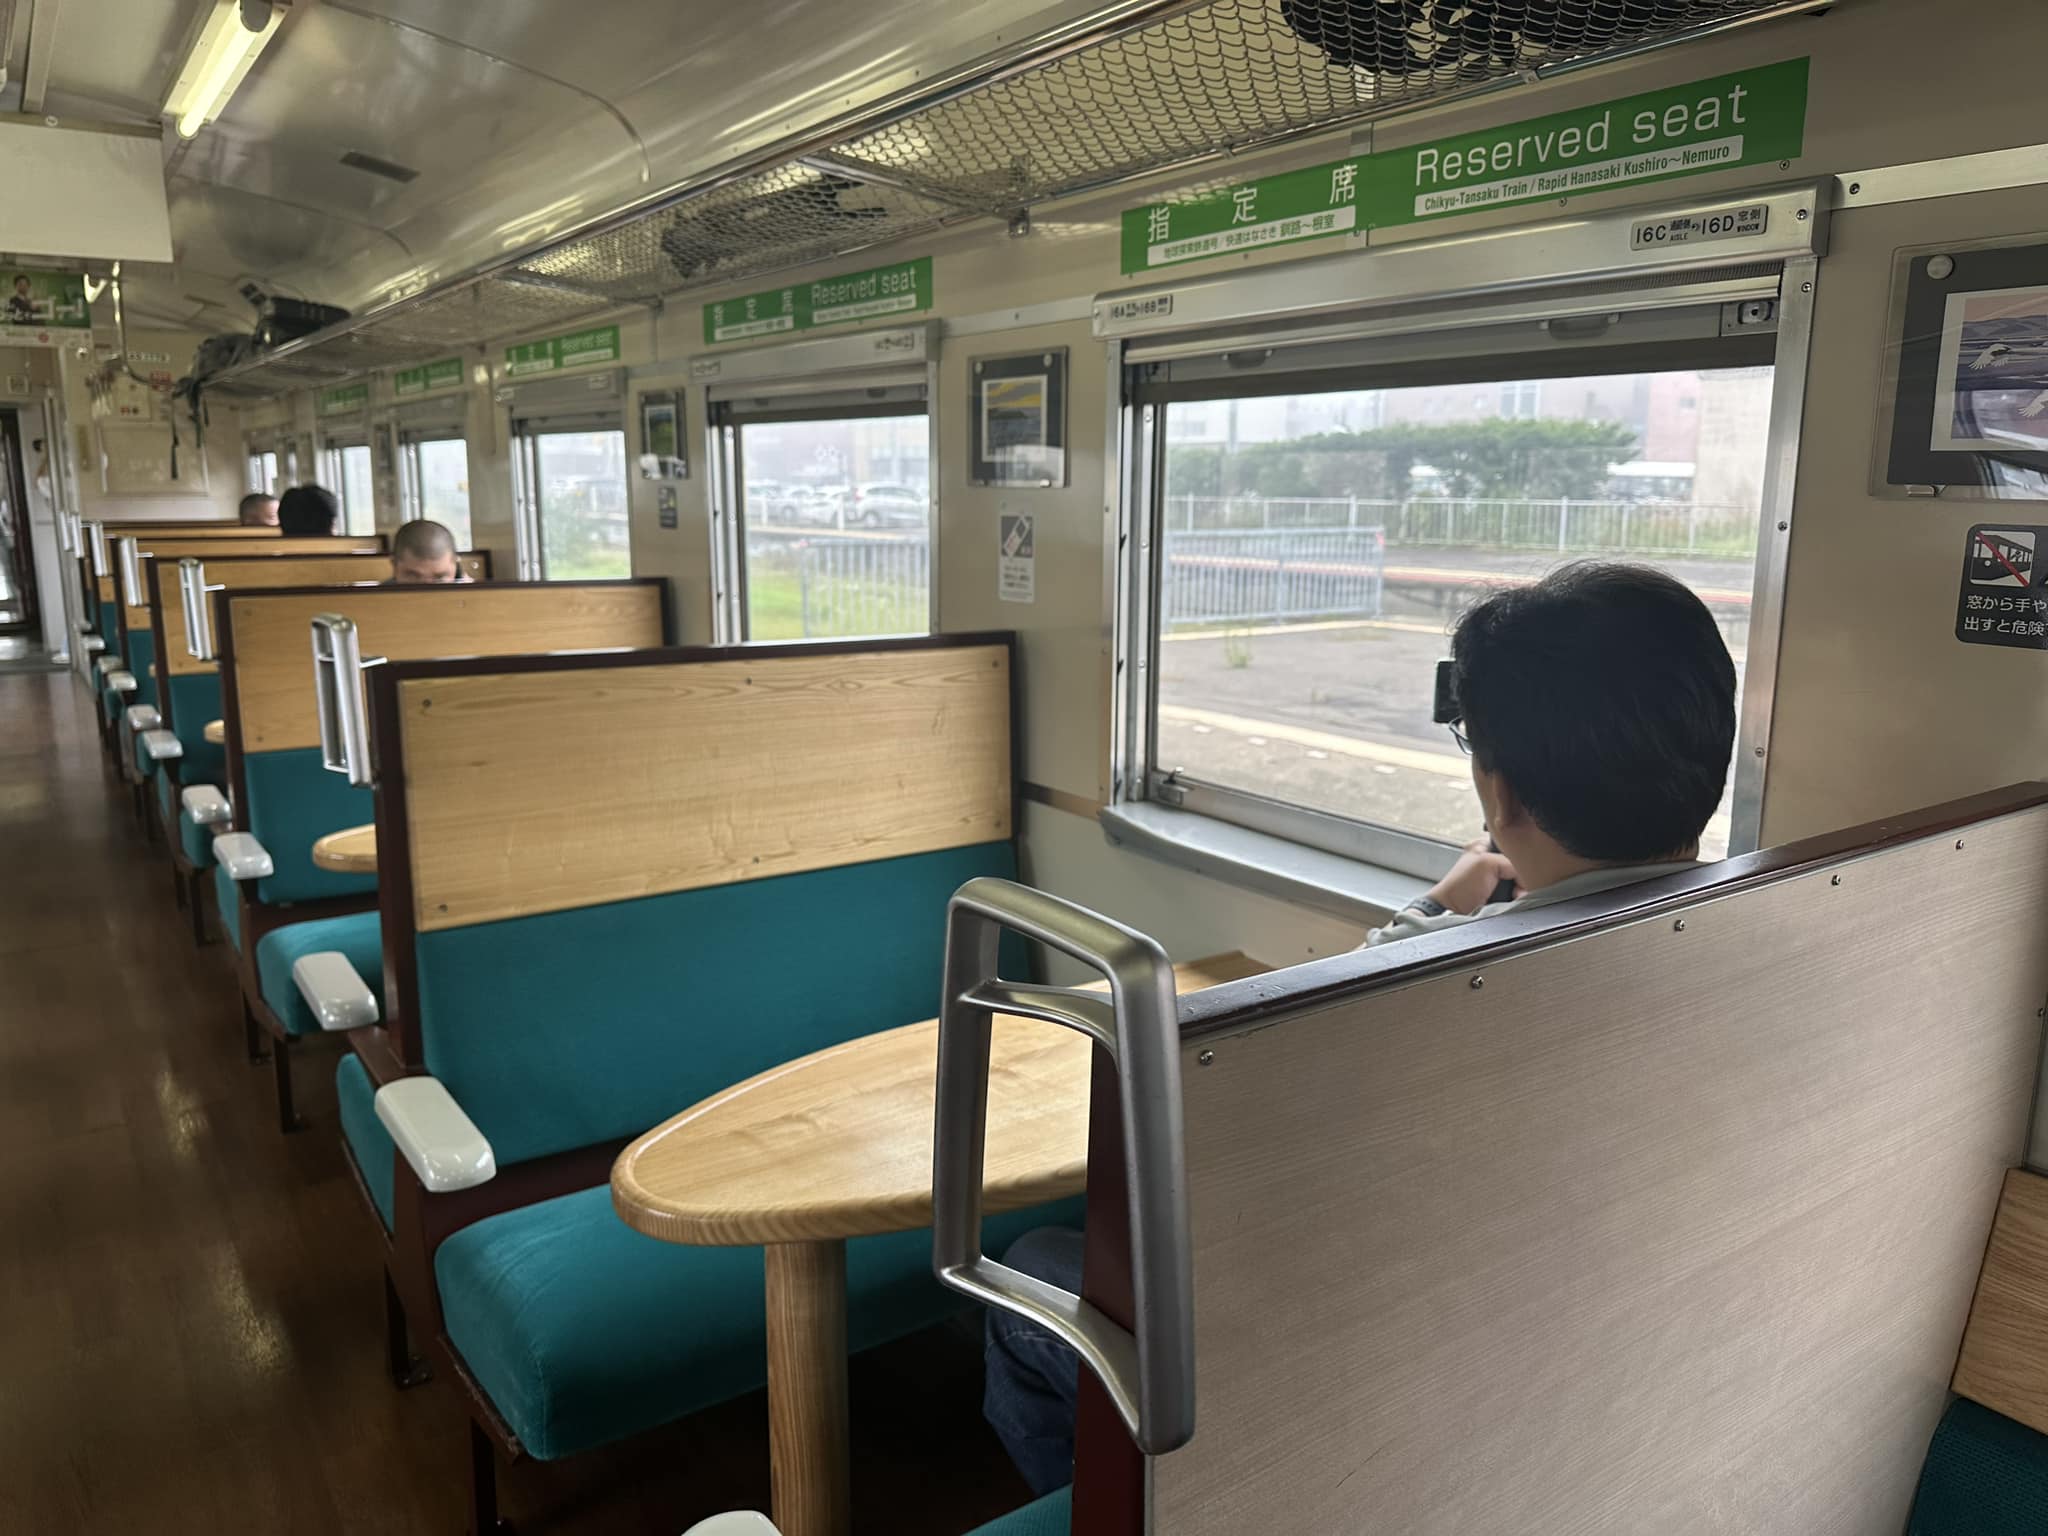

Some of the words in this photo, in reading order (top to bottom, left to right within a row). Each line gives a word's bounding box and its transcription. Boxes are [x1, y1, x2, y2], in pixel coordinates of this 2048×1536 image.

[1416, 111, 1611, 186] Reserved
[1632, 84, 1748, 144] seat
[1424, 187, 1499, 210] Chikyu-Tansaku
[1502, 182, 1527, 198] Train
[1538, 174, 1567, 192] Rapid
[1571, 164, 1620, 185] Hanasaki
[1636, 225, 1666, 244] 16C
[1702, 215, 1734, 235] 16D
[811, 273, 876, 306] Reserved
[881, 266, 916, 294] seat
[1964, 616, 2048, 637] 出すと危険
